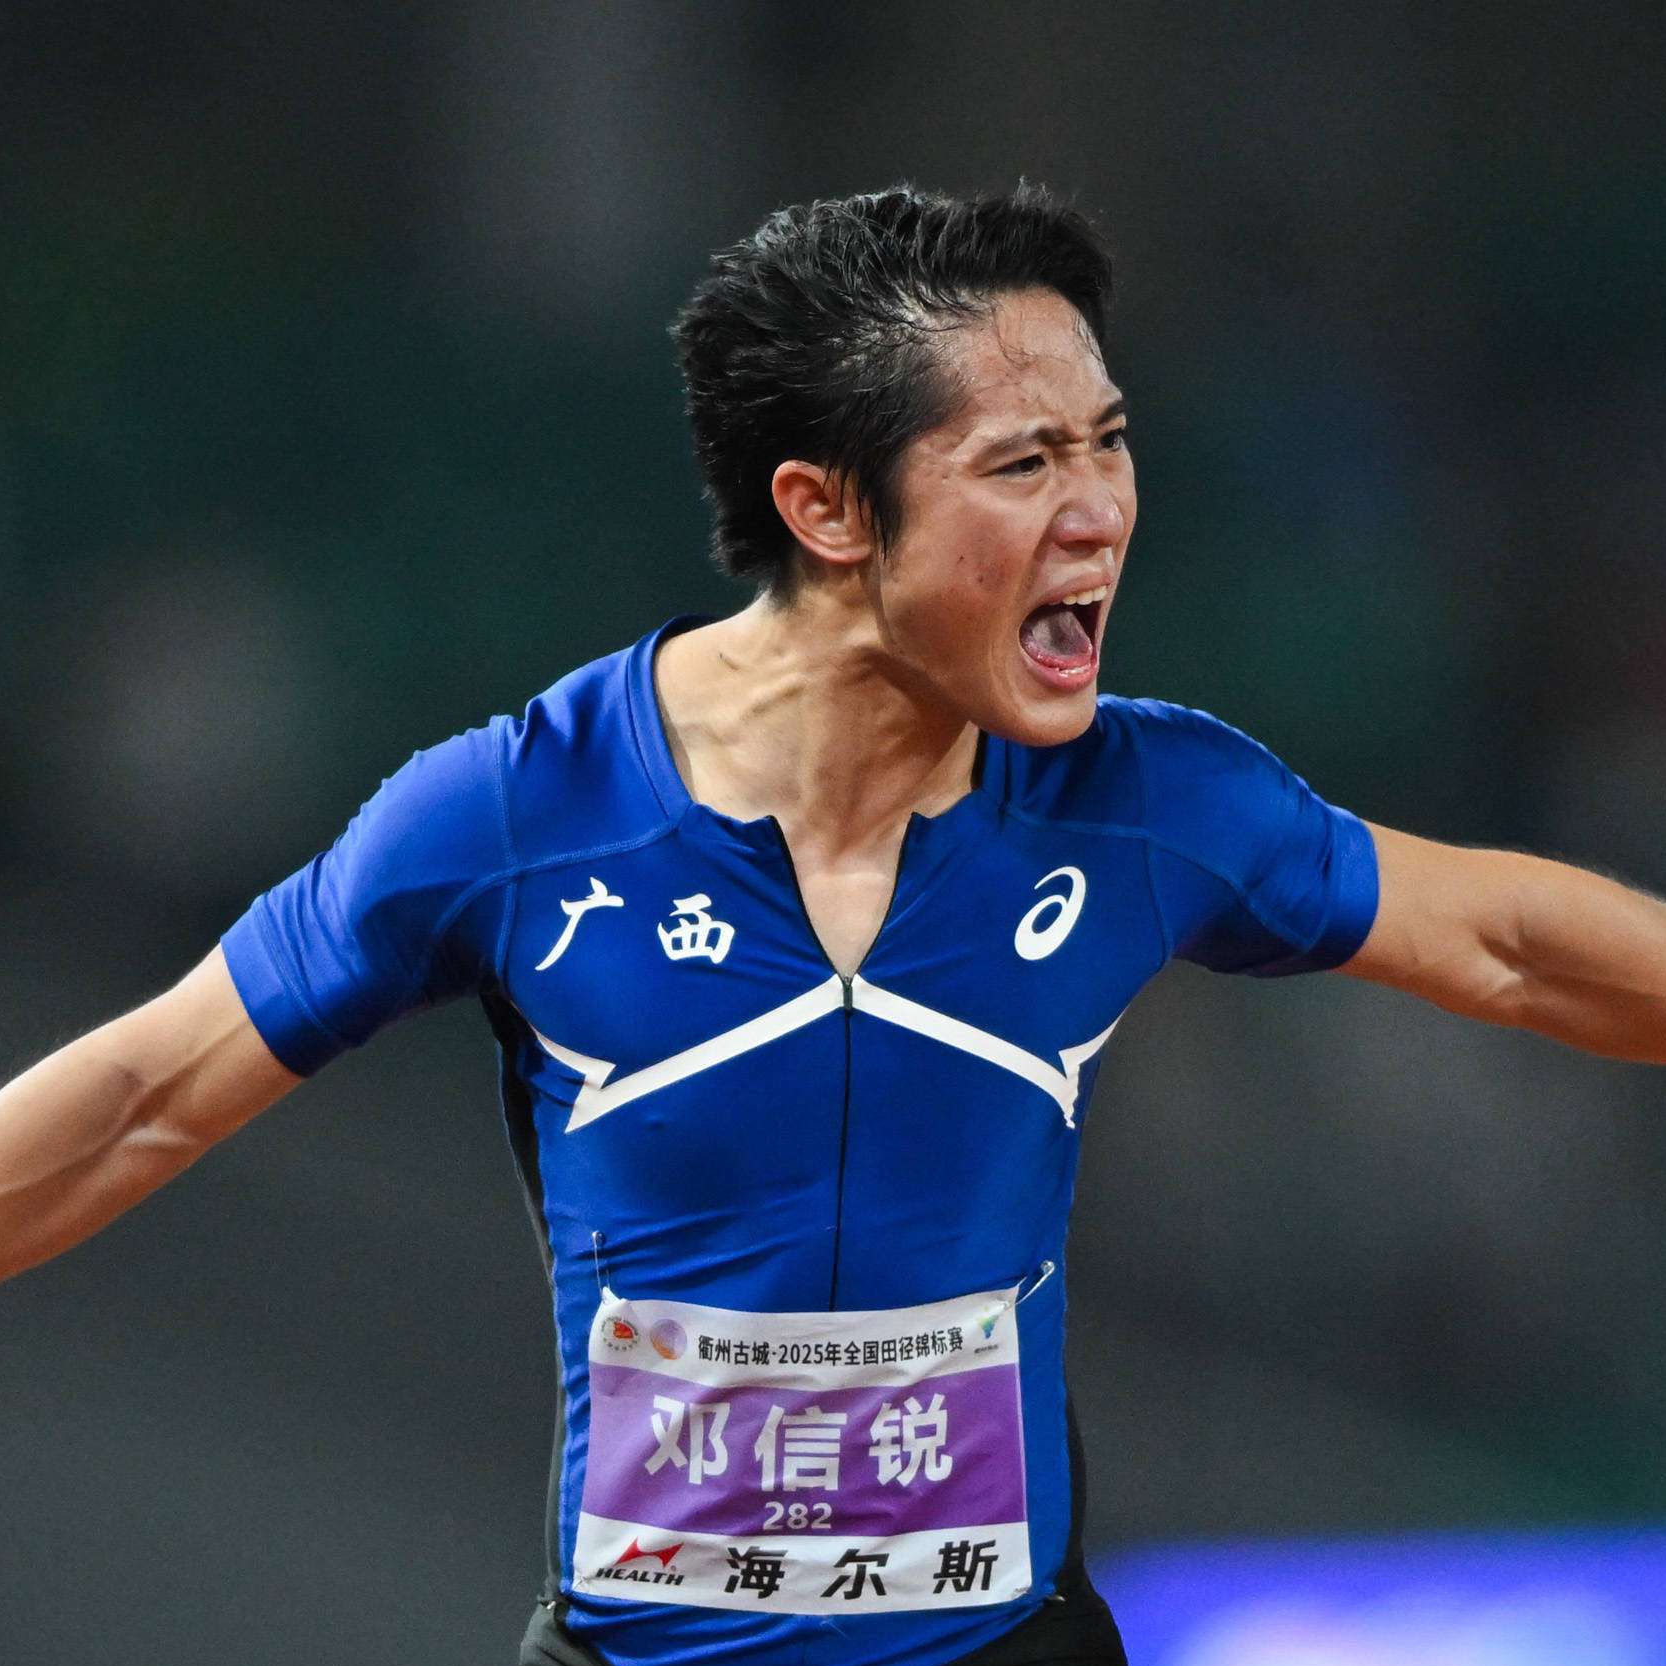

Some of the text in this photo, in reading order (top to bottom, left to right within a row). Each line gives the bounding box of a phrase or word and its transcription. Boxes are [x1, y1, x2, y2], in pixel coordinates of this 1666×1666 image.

[535, 876, 736, 971] 广西
[644, 1393, 954, 1492] 邓信锐
[762, 1501, 833, 1531] 282
[595, 1567, 685, 1586] HEALTH
[724, 1539, 999, 1600] 海尔斯
